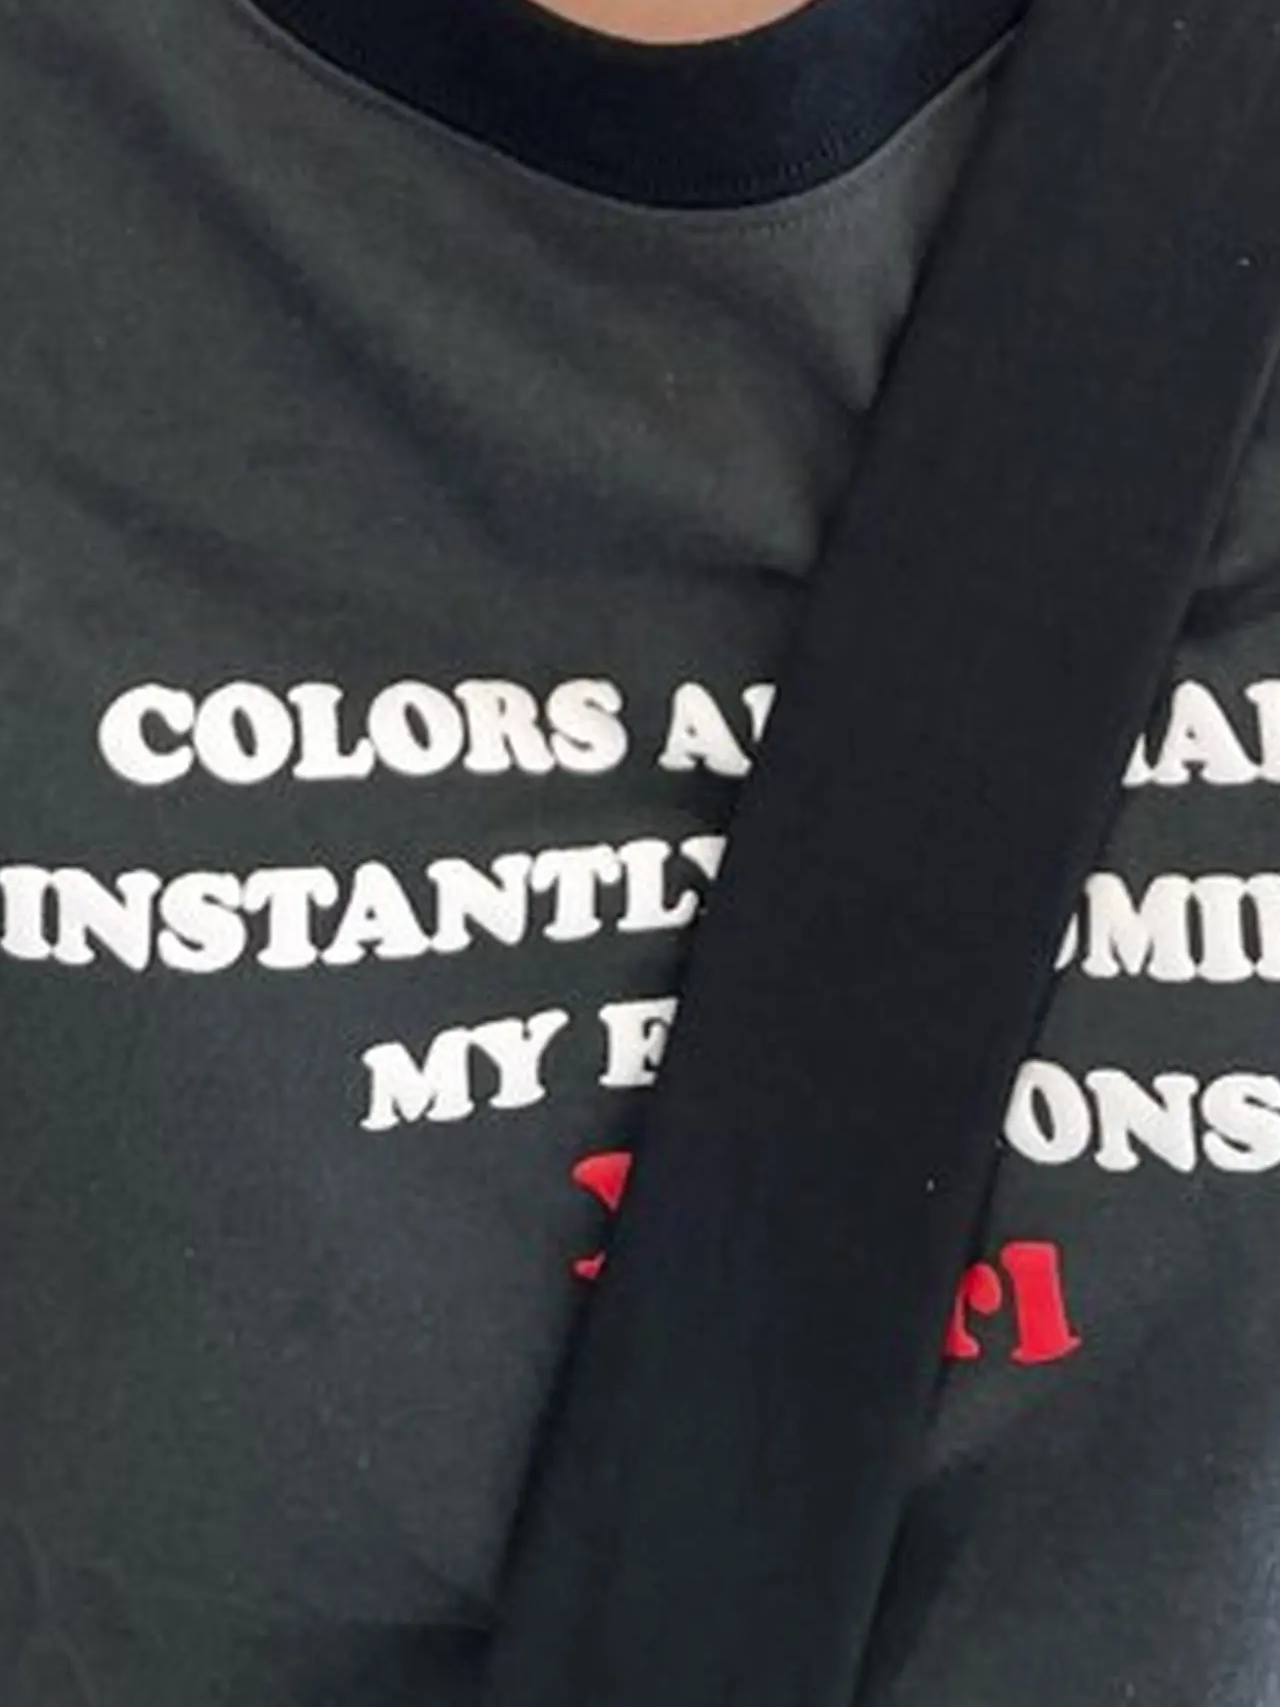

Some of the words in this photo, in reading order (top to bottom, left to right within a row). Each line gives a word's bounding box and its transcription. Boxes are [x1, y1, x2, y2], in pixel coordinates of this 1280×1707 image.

[97, 678, 629, 787] COLORS
[657, 681, 777, 777] A
[359, 1007, 570, 1132] MY
